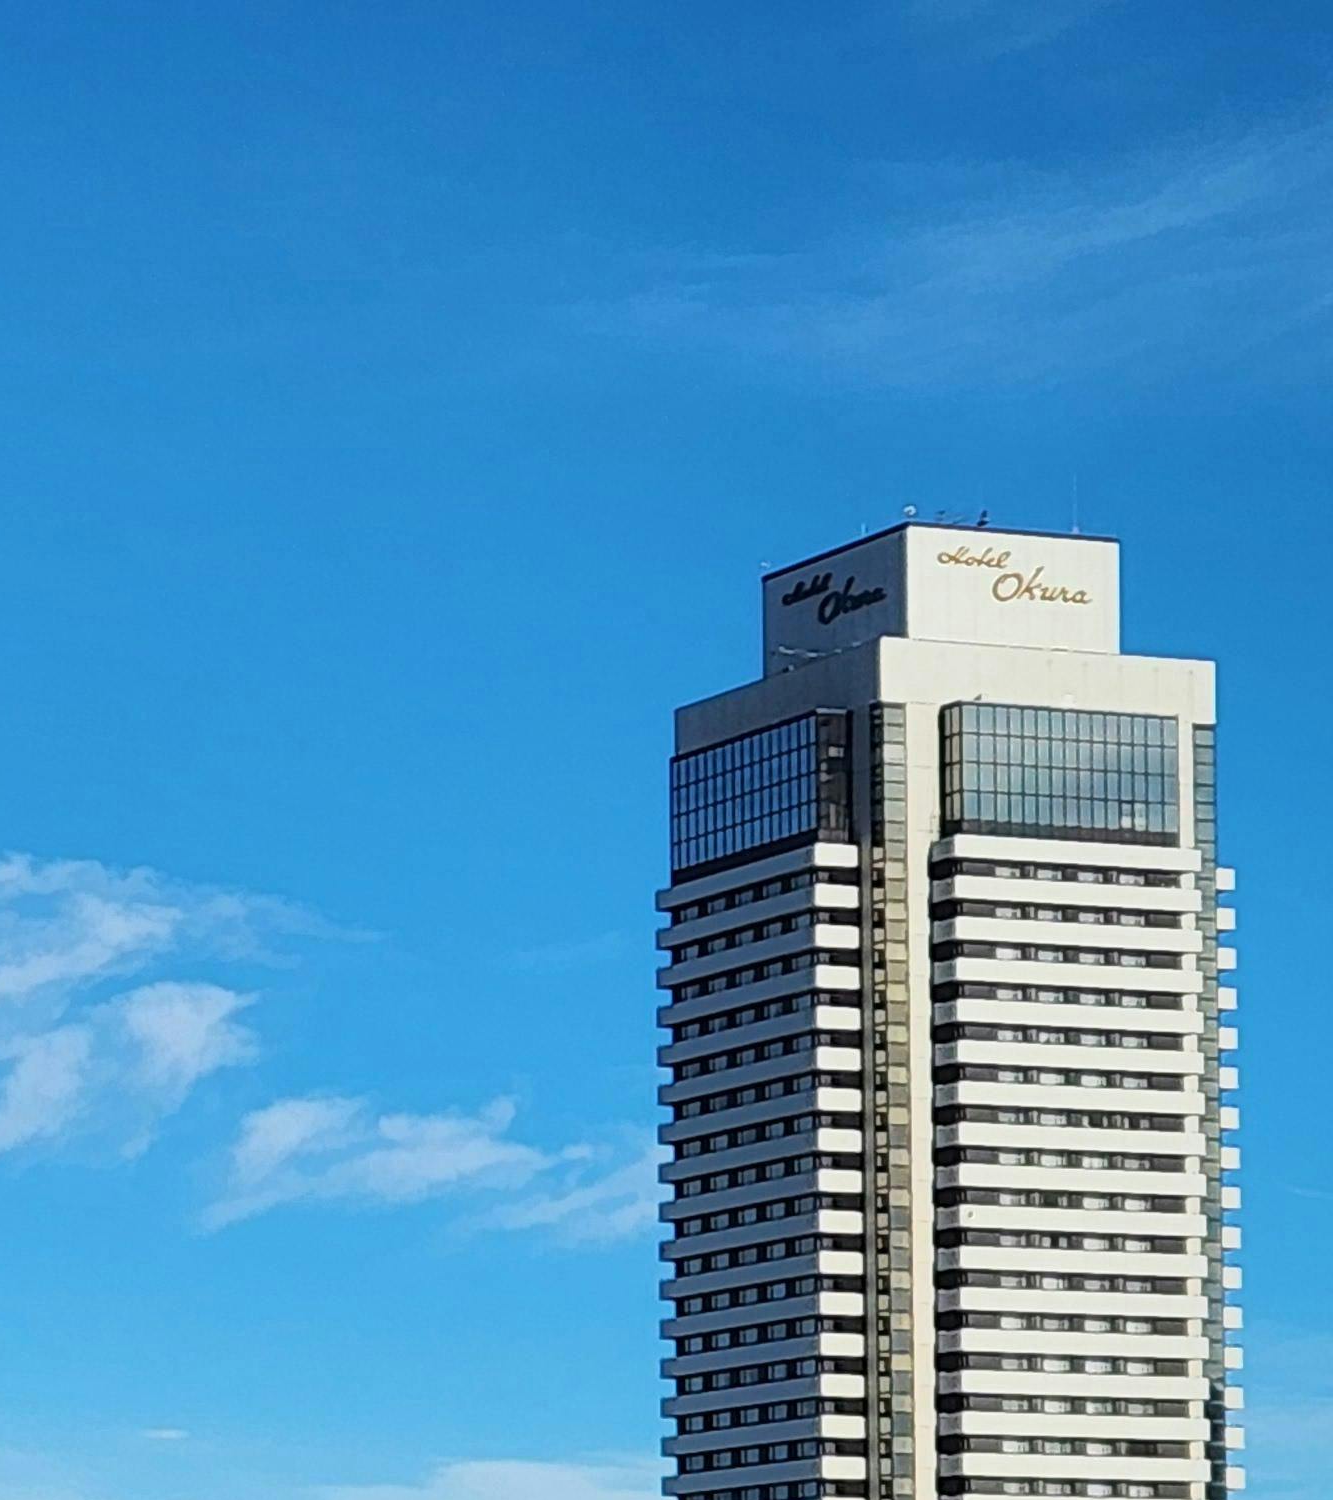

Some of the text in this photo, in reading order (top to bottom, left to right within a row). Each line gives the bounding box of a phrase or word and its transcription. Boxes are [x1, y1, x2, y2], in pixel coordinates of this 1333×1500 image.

[936, 546, 1012, 569] Hotel
[818, 575, 888, 625] Okura
[992, 566, 1093, 605] Okura
